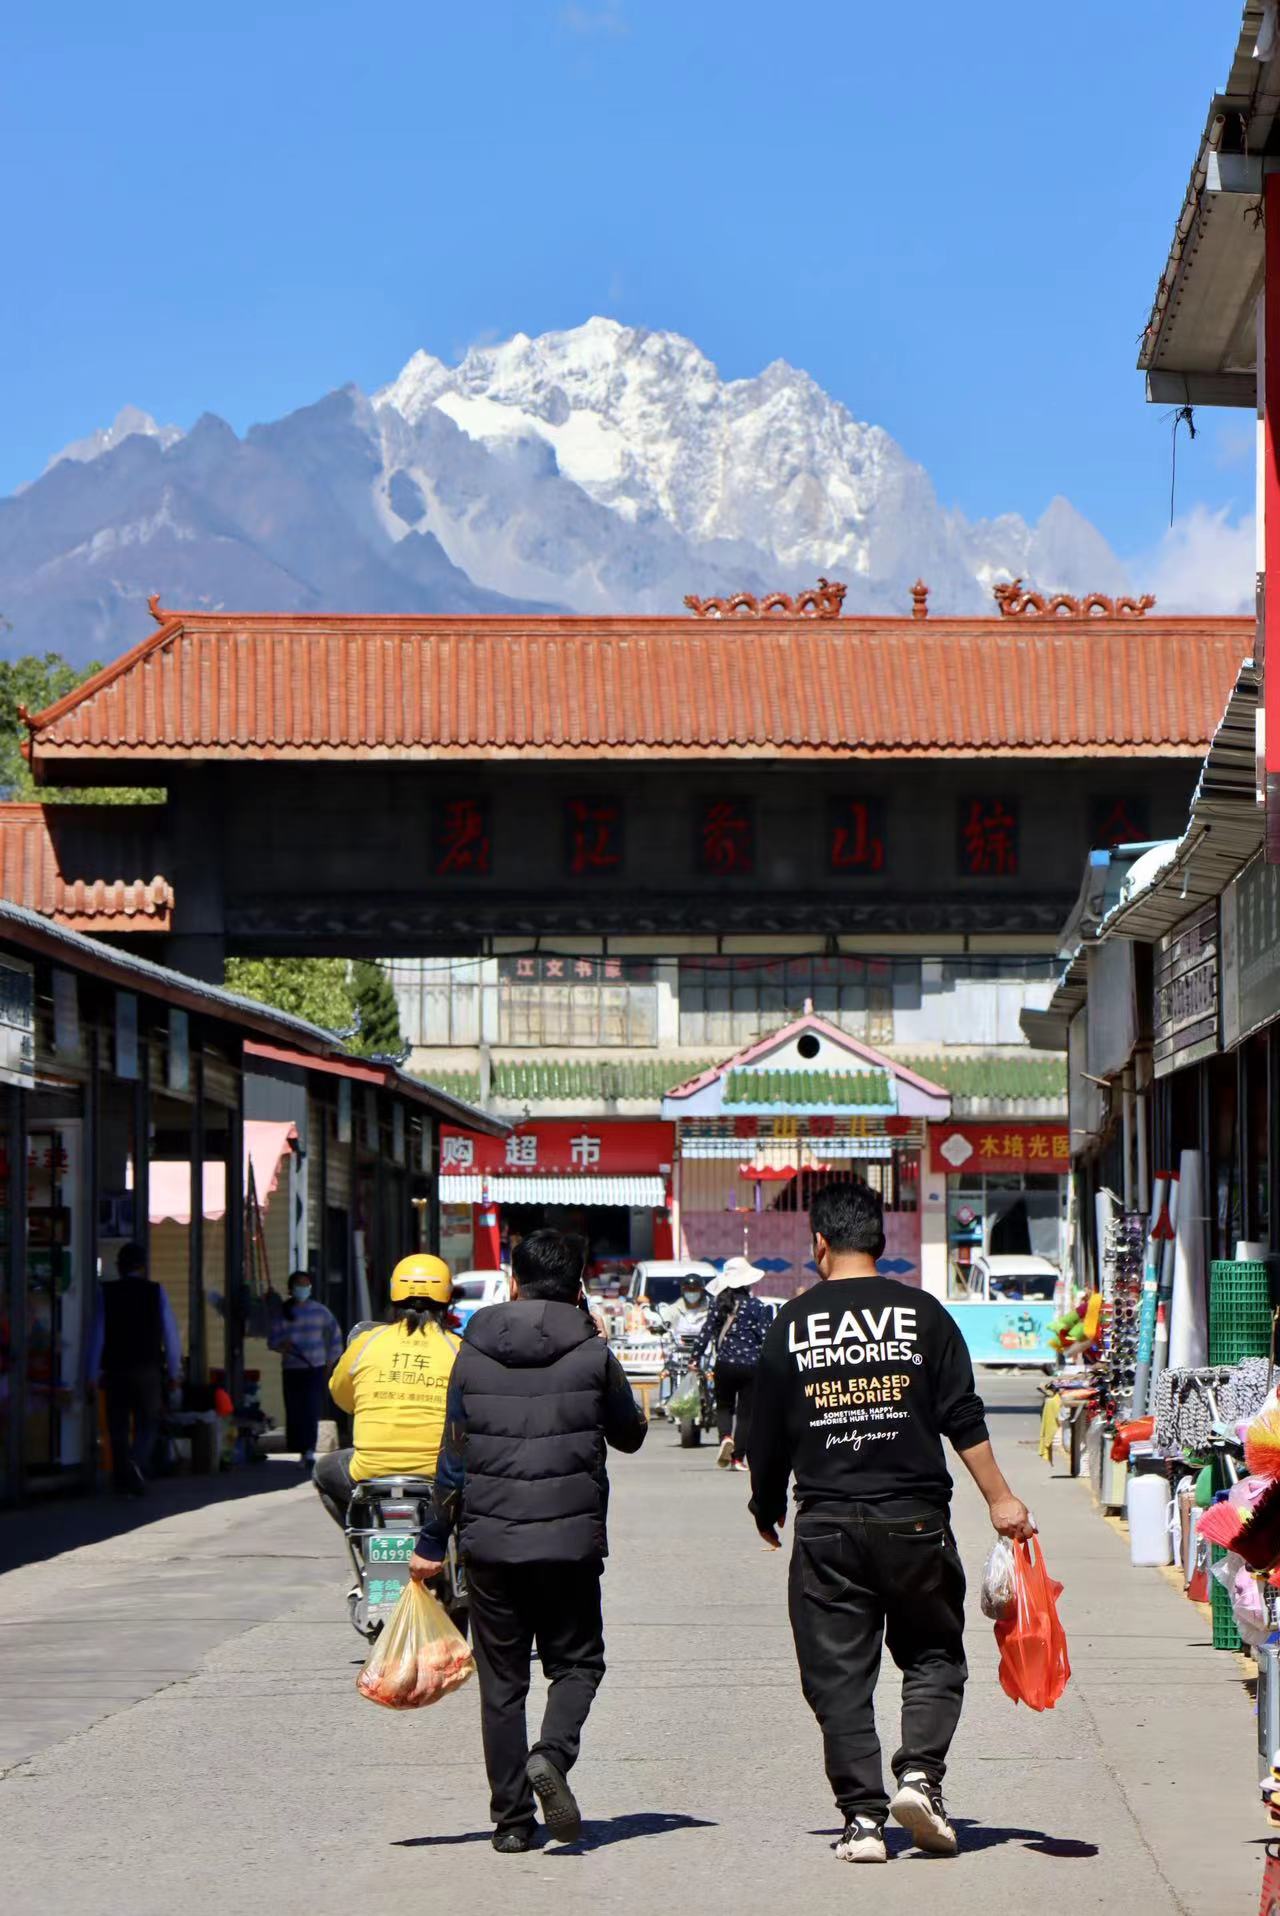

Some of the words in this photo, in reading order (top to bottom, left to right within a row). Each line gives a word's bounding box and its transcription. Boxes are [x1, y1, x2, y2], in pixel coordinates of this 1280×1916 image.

[443, 1135, 600, 1166] 购超市
[788, 1307, 917, 1353] LEAVE
[392, 1352, 432, 1370] 打车
[804, 1381, 842, 1397] WISH
[848, 1375, 910, 1391] ERASED
[815, 1388, 902, 1408] MEMORIES
[869, 1406, 894, 1414] HAPPY
[809, 1418, 848, 1427] MEMORIES
